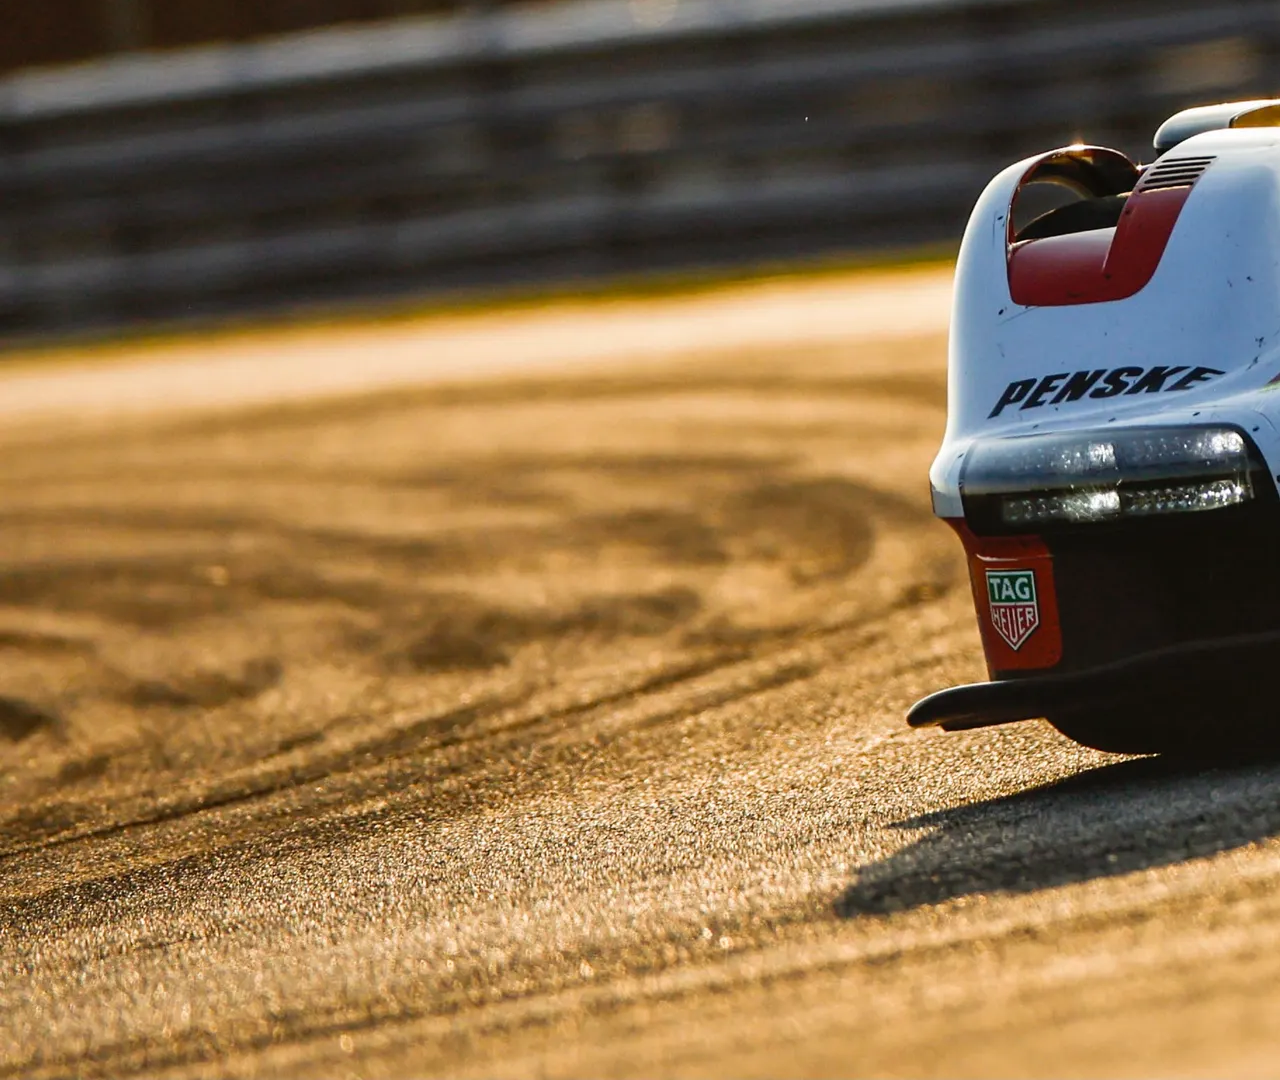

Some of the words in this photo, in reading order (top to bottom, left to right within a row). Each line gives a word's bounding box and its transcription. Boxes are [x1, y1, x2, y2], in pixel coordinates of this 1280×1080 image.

[987, 366, 1226, 419] PENSKE
[989, 577, 1031, 601] TAG
[991, 606, 1036, 643] HEUER
